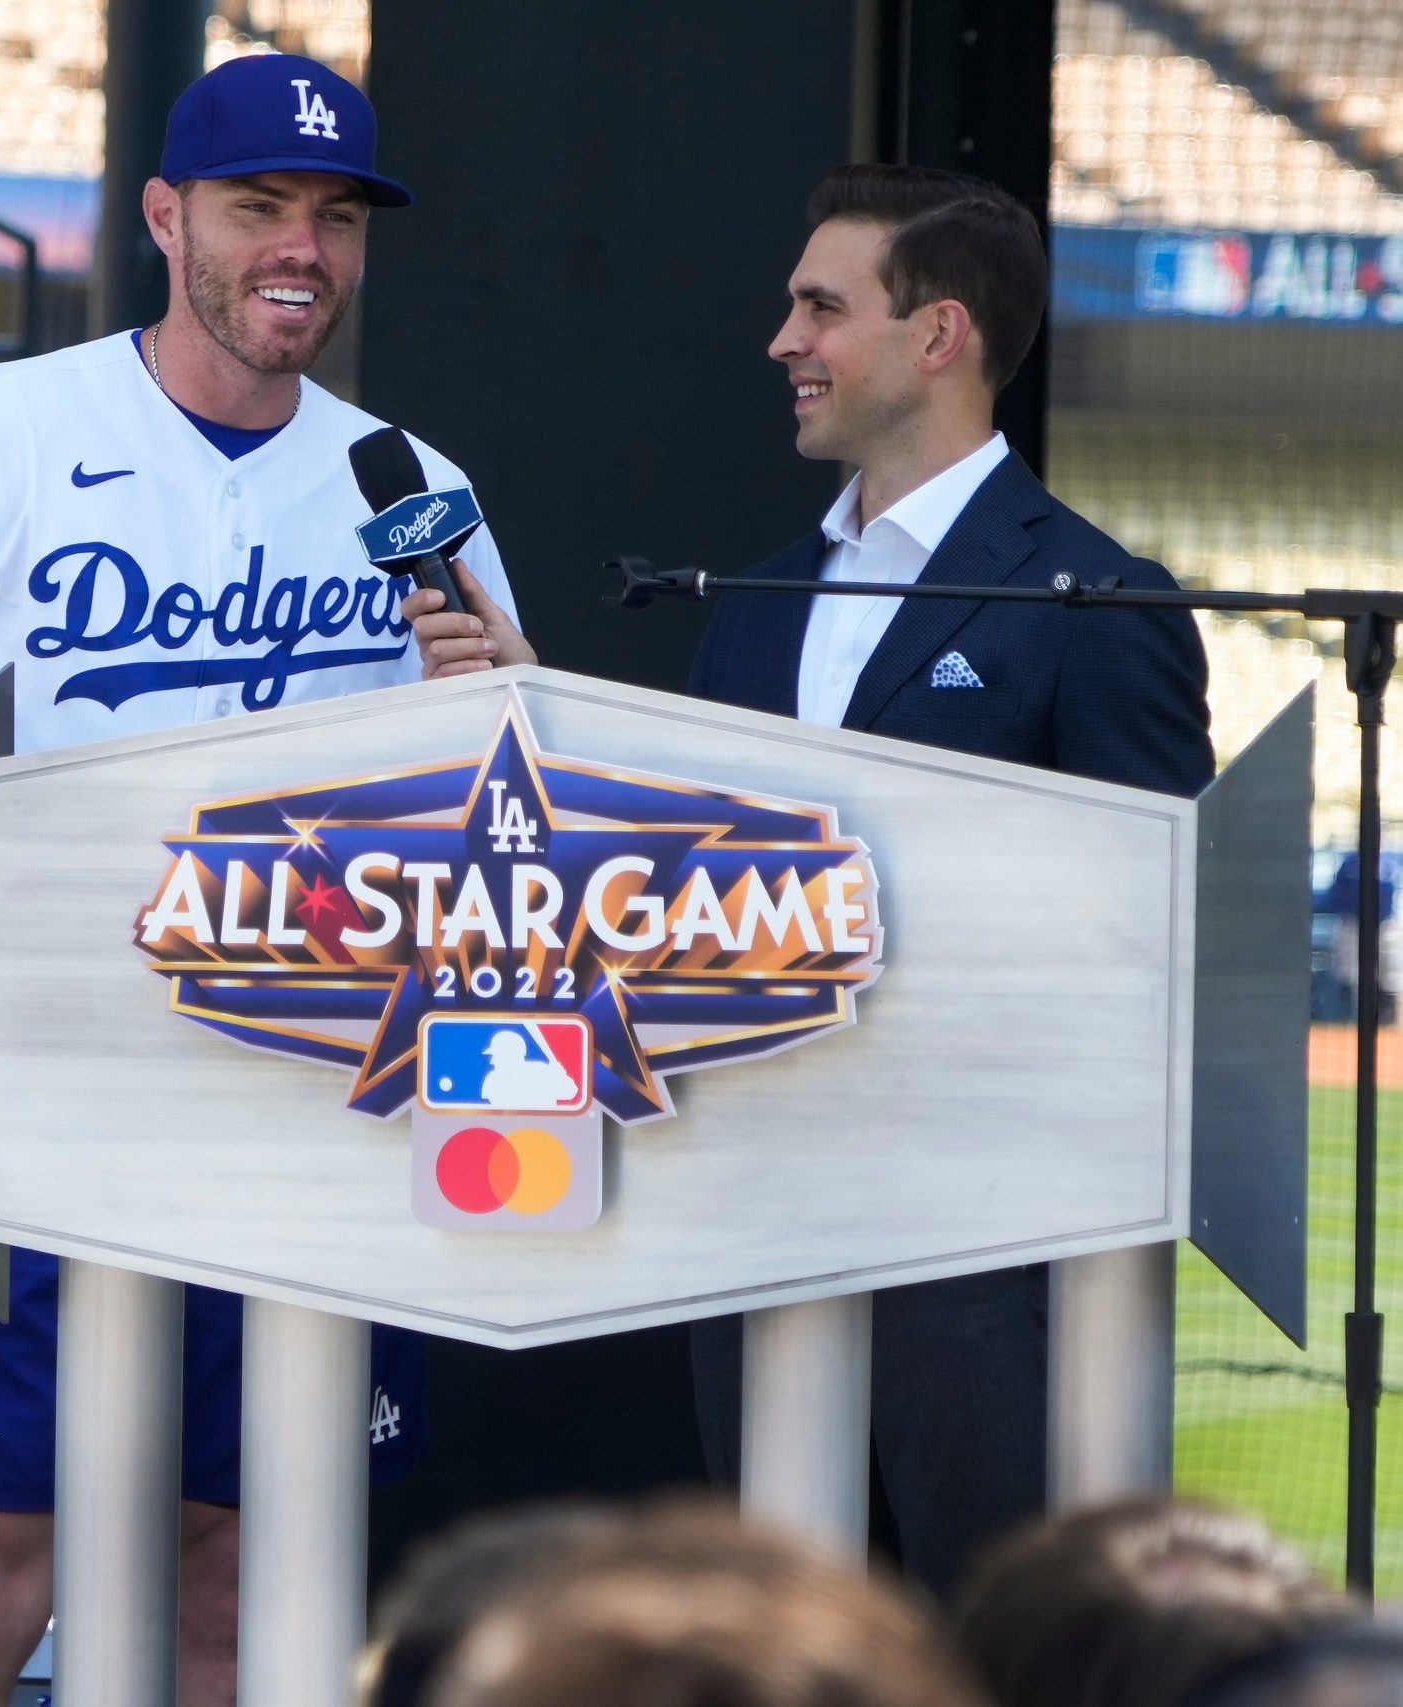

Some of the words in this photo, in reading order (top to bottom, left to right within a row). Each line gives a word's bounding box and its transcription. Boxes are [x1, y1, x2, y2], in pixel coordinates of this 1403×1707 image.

[290, 79, 340, 140] LA
[388, 496, 449, 553] Dodgers
[488, 780, 537, 853] LA
[141, 849, 307, 944] ALL
[339, 852, 565, 949] STAR
[584, 855, 871, 953] GAME
[433, 966, 576, 1000] 2022
